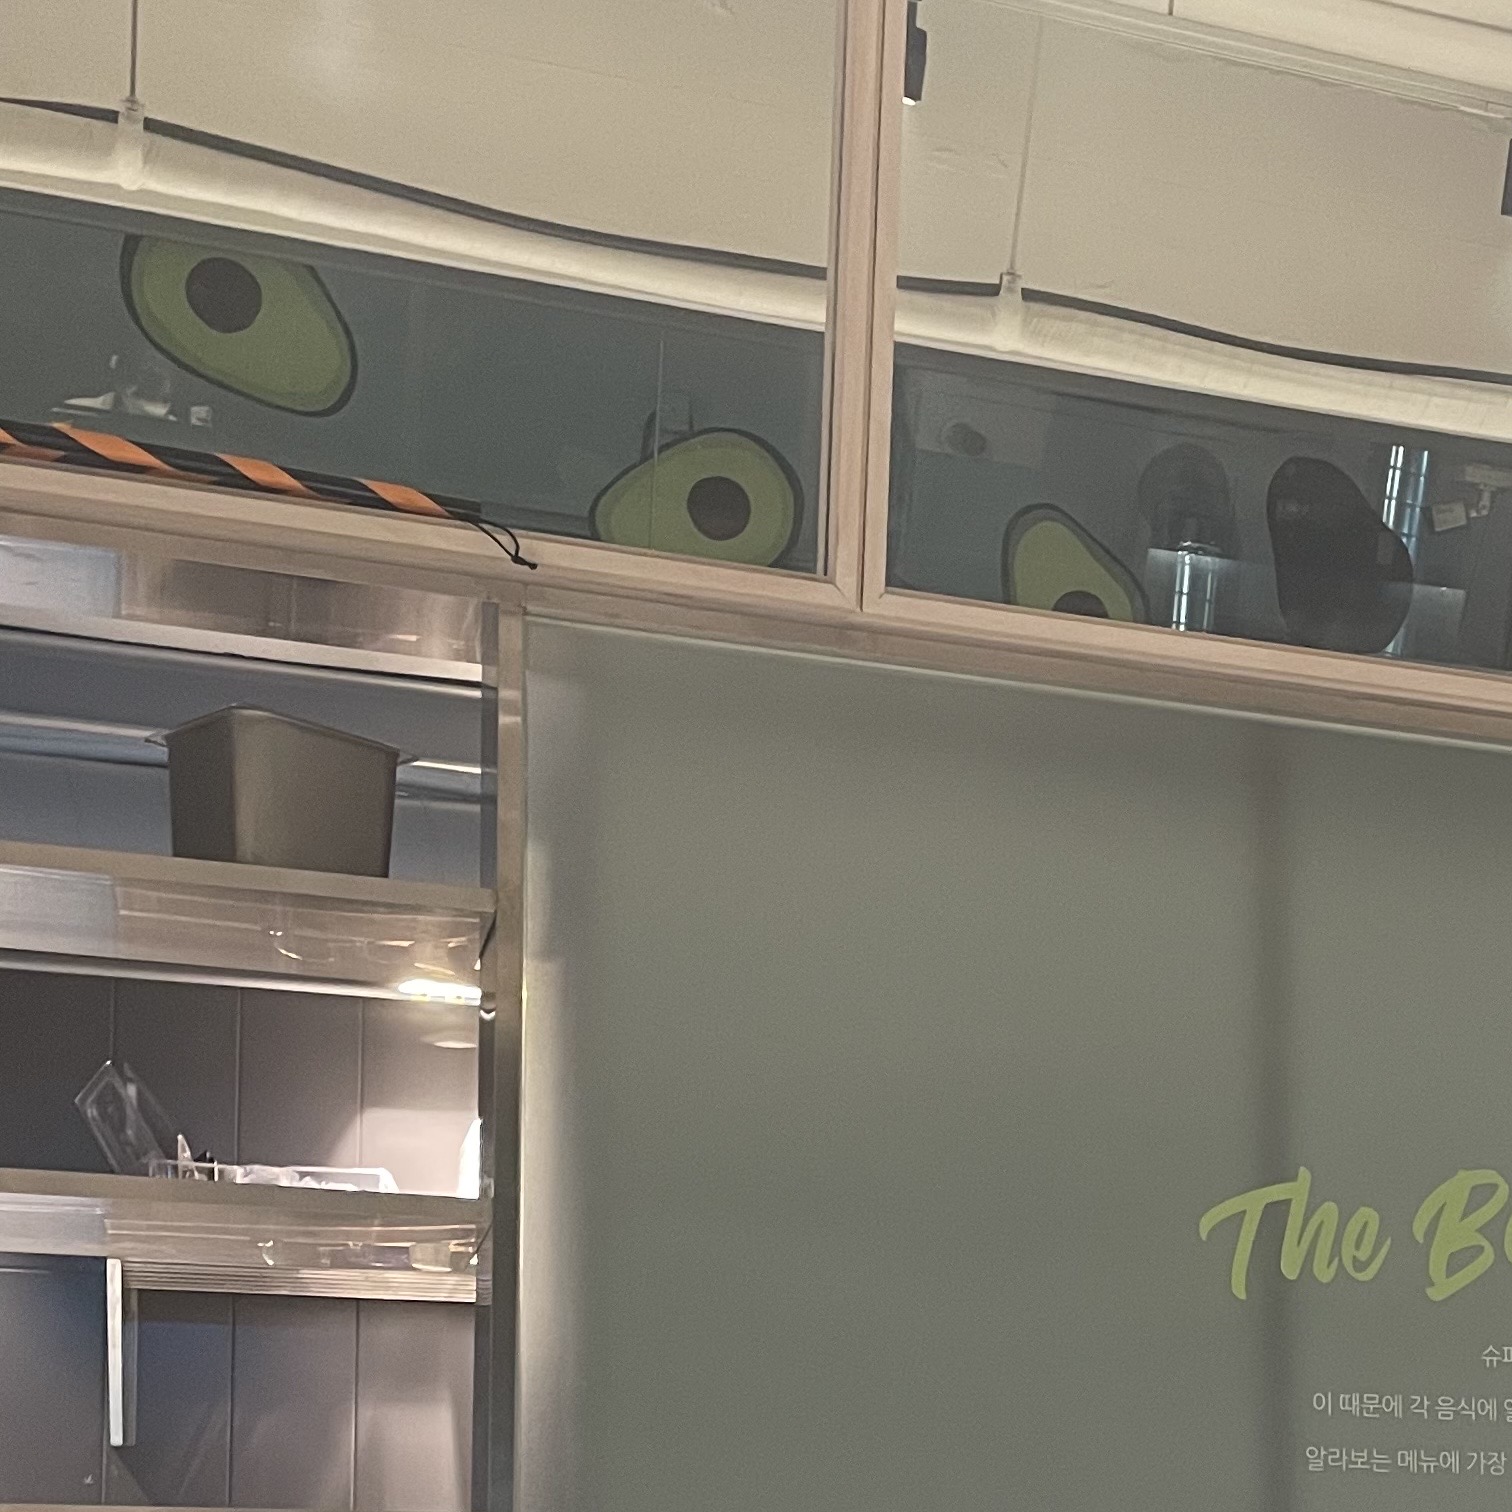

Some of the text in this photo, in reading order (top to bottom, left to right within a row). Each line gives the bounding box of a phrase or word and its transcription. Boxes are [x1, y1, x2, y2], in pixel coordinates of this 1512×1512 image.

[1199, 1166, 1392, 1300] The
[1312, 1392, 1332, 1416] 이
[1339, 1393, 1403, 1419] 때문에
[1410, 1395, 1430, 1420] 각
[1434, 1396, 1497, 1422] 음식에
[1306, 1446, 1392, 1473] 알라보는
[1398, 1449, 1460, 1474] 메뉴에
[1466, 1451, 1507, 1476] 가장
